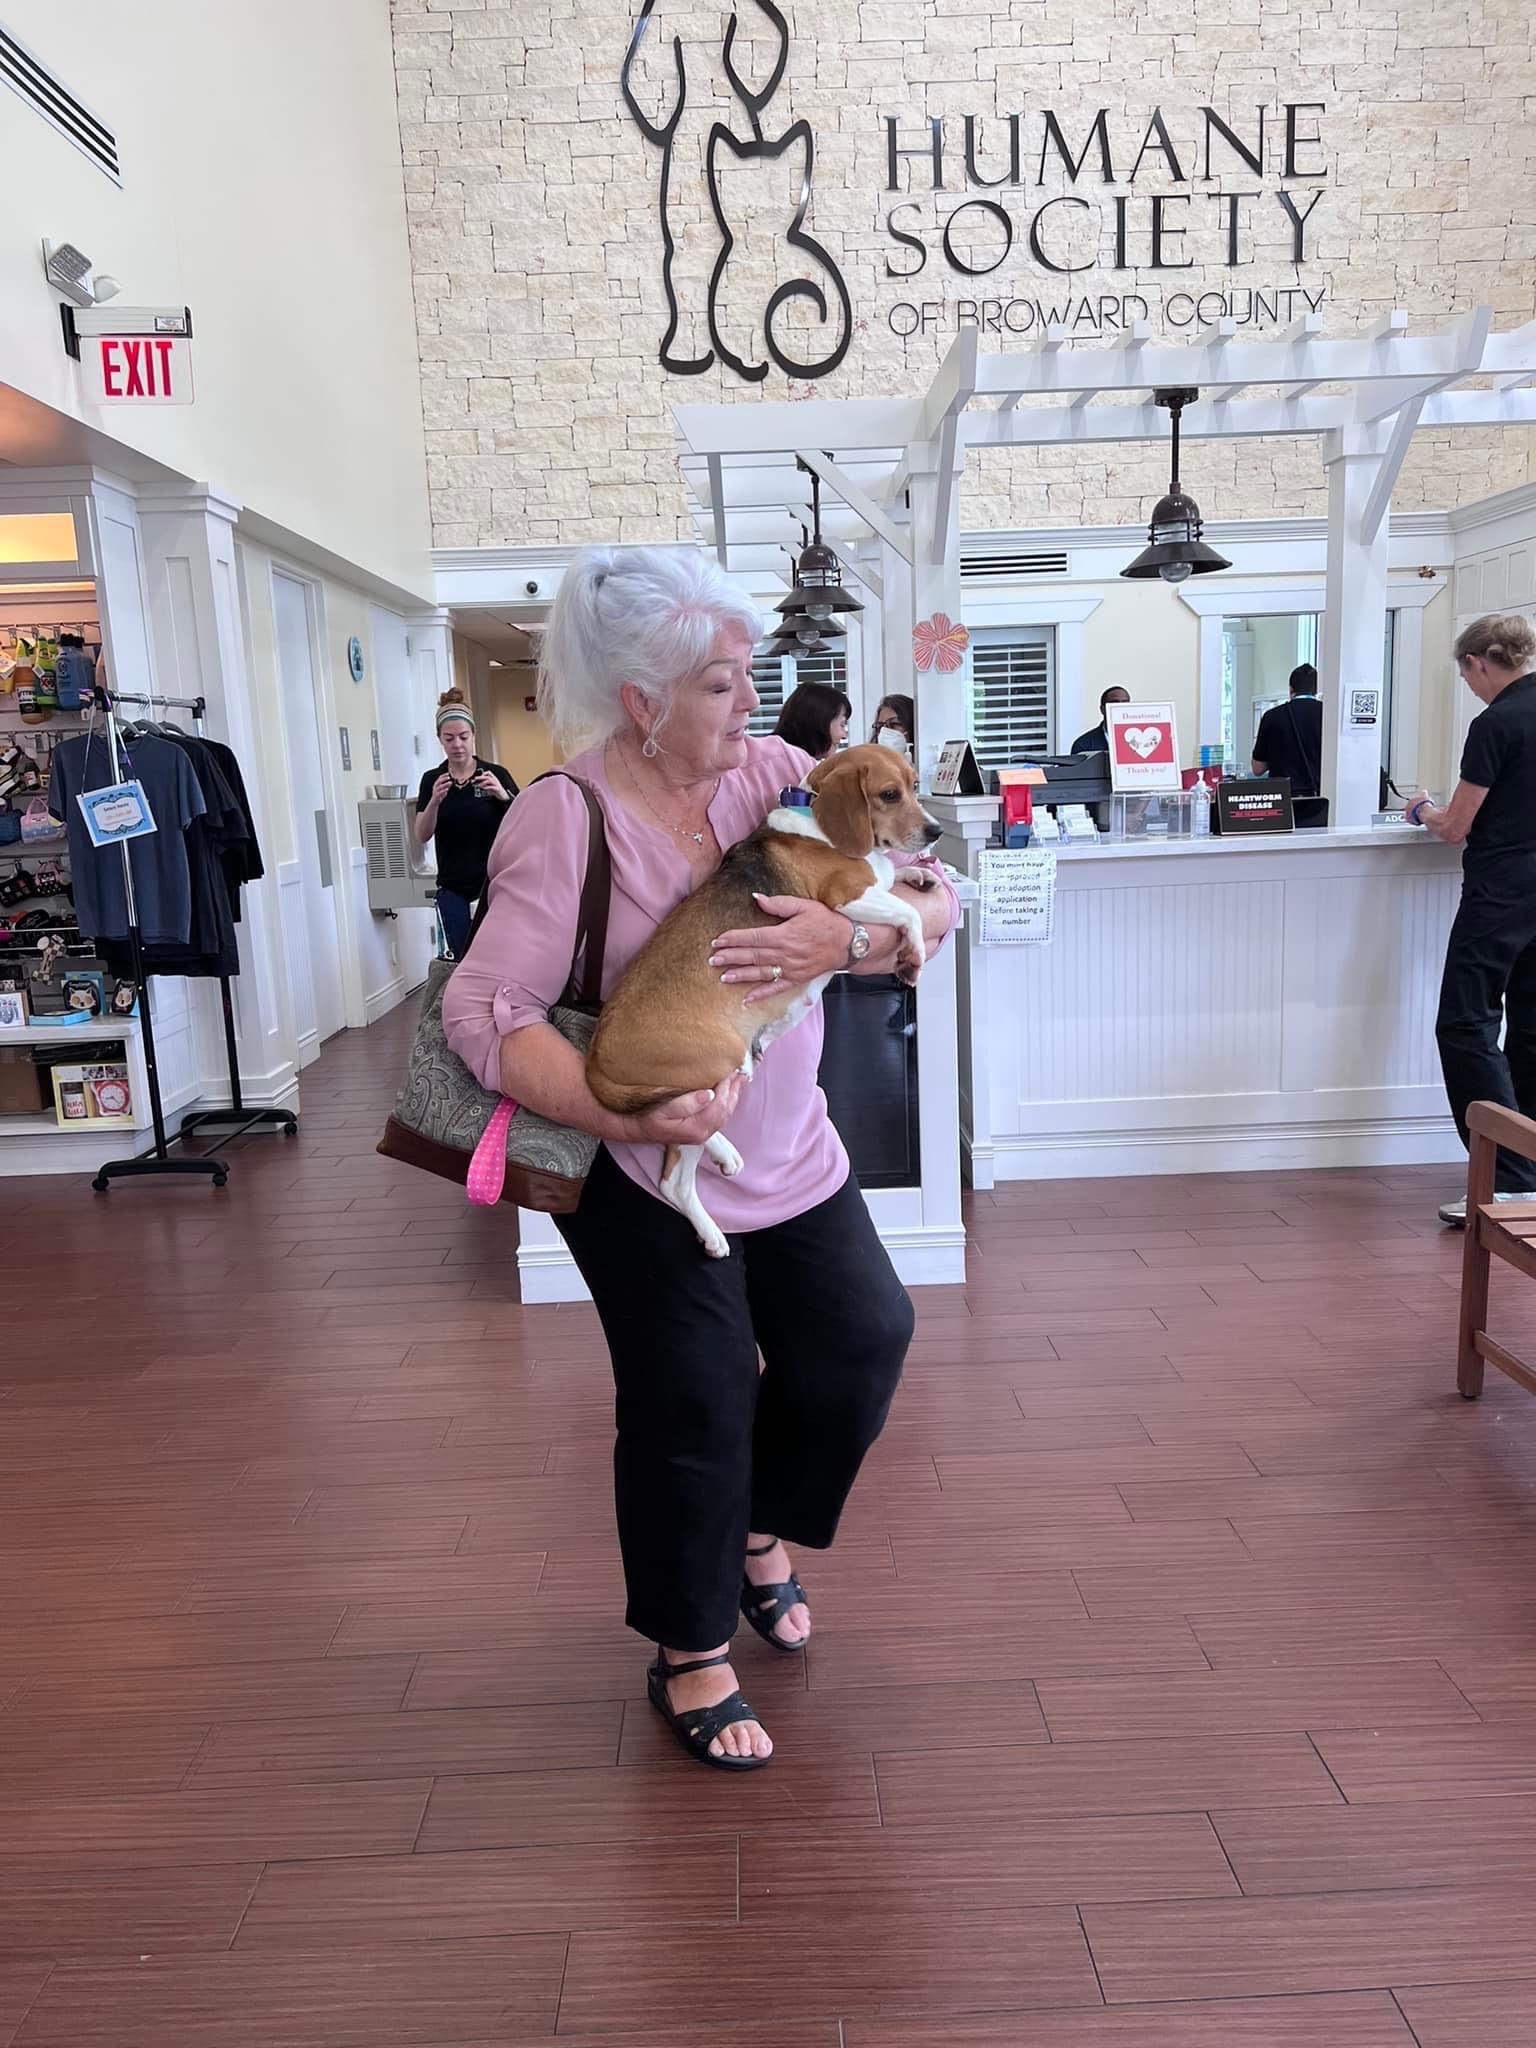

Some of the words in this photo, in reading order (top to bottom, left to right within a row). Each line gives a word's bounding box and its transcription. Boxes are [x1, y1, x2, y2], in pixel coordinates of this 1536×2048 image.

[884, 103, 1327, 190] HUMANE
[886, 191, 1324, 276] SOCIETY
[888, 302, 938, 336] OF
[957, 295, 1149, 333] BROWARD
[1166, 288, 1326, 326] COUNTY
[101, 341, 173, 397] EXIT
[1228, 793, 1282, 803] HEARTWORM
[1238, 802, 1273, 810] DISEASE
[997, 895, 1038, 904] application
[1015, 906, 1038, 915] taking
